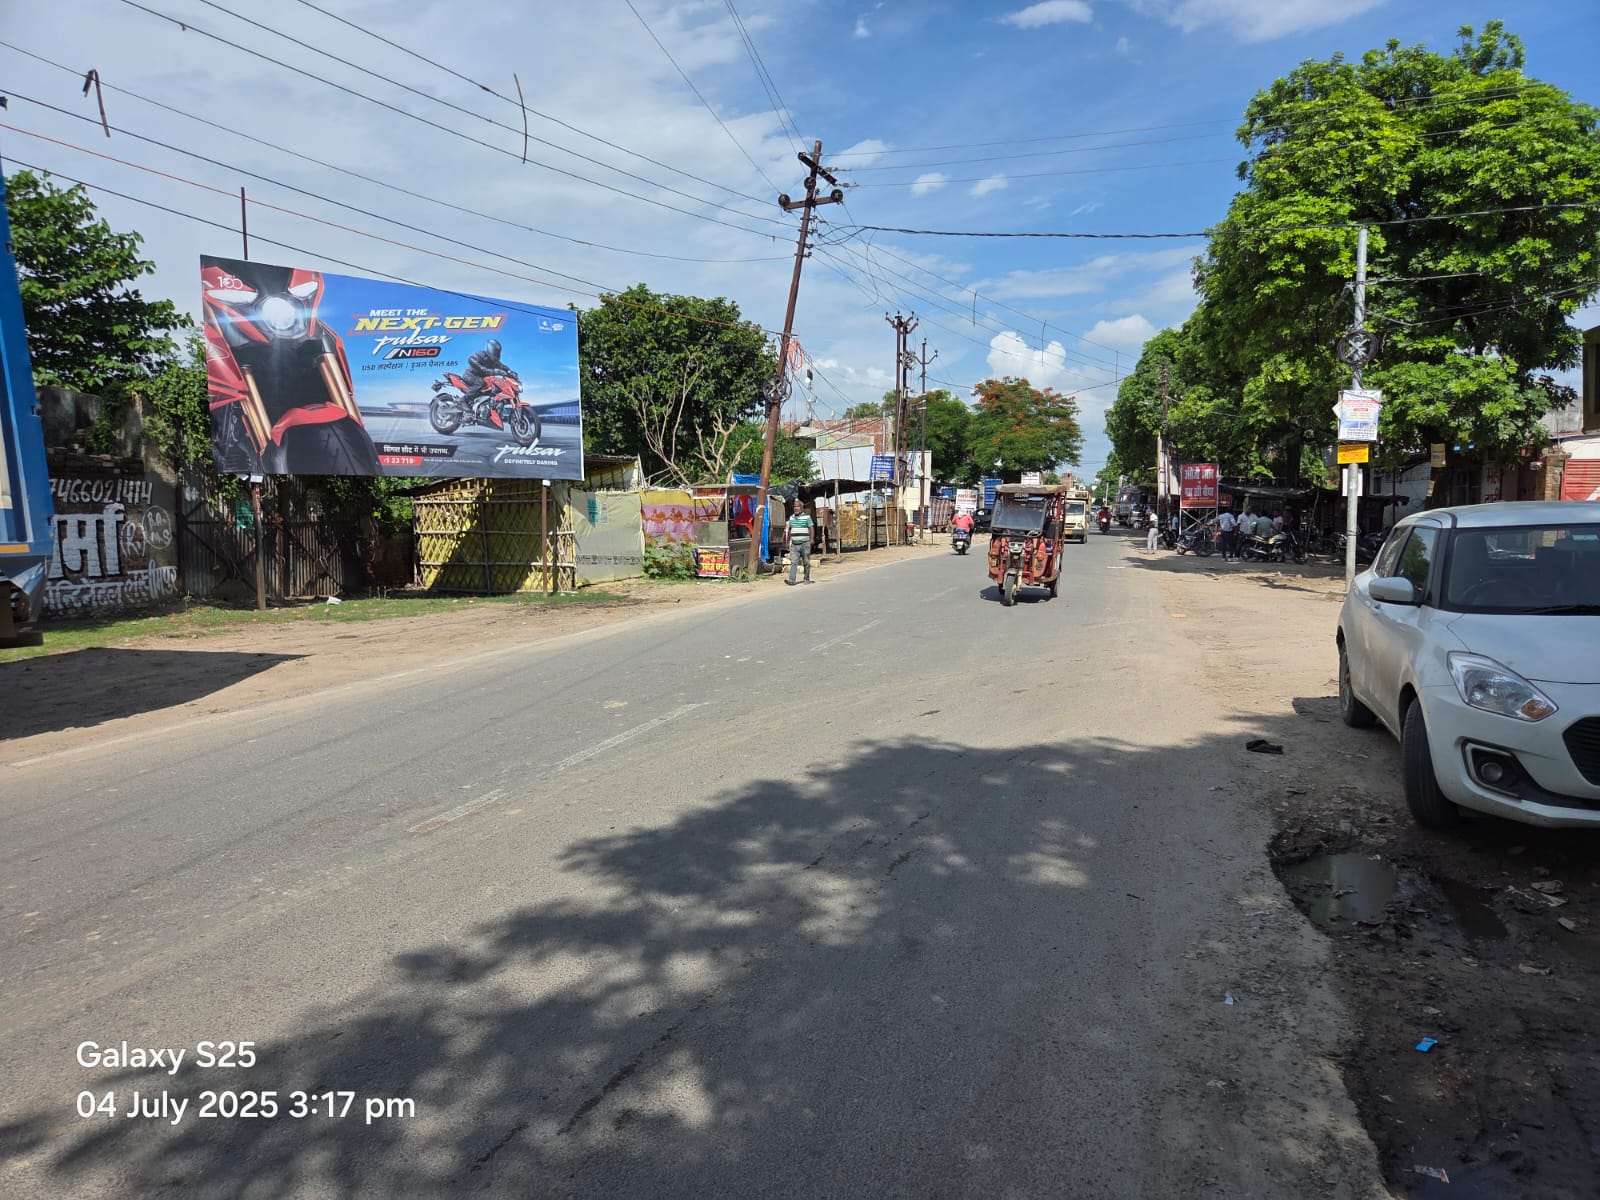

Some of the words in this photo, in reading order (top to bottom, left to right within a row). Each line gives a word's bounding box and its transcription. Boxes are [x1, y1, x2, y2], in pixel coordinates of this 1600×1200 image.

[369, 308, 402, 317] MEET
[406, 308, 428, 316] THE
[354, 316, 502, 331] NEXT-GEN
